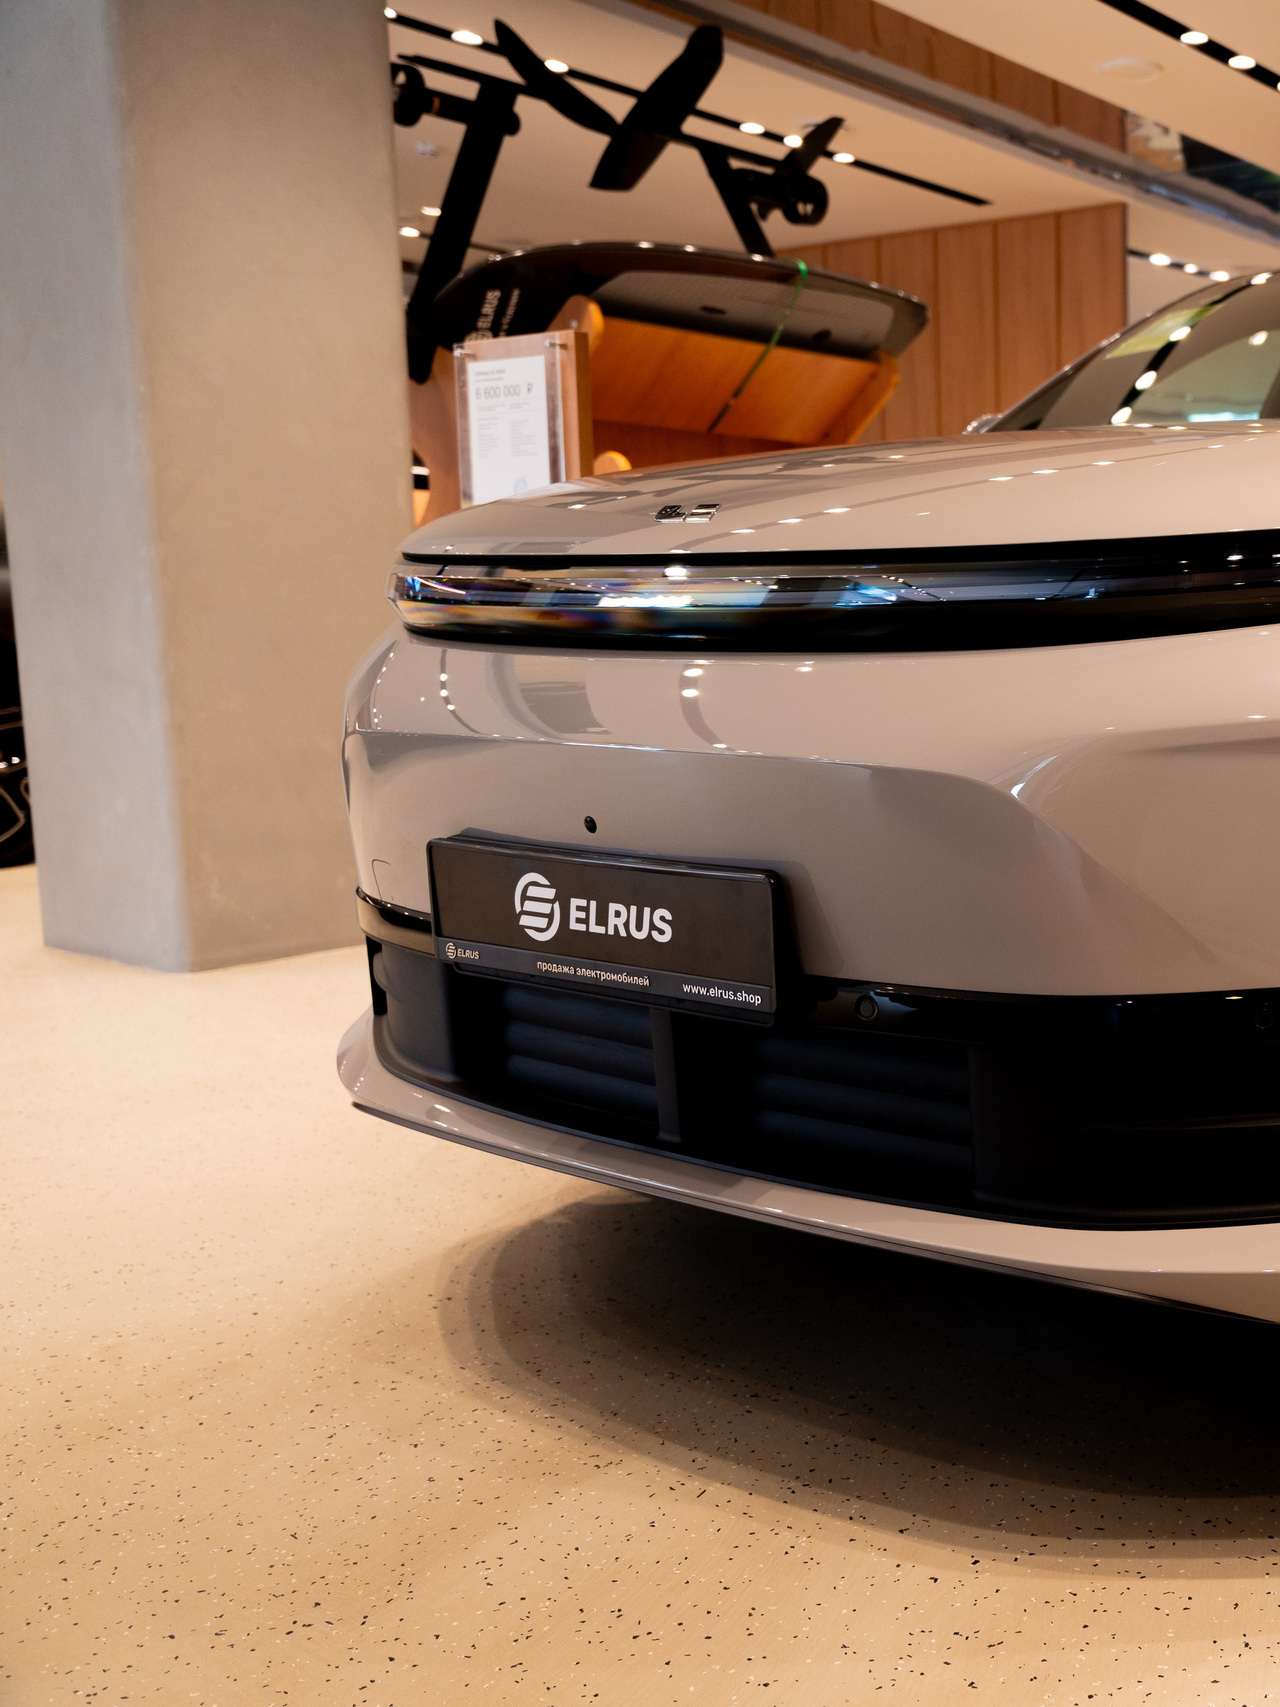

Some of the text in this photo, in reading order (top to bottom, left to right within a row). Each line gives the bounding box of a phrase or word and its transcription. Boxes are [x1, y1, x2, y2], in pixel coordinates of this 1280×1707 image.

[477, 289, 501, 329] ELRUS
[569, 897, 673, 943] ELRUS
[457, 949, 480, 960] ELRUS
[536, 961, 650, 986] продажа электромобилей
[682, 983, 762, 1006] www.elrus.shop
